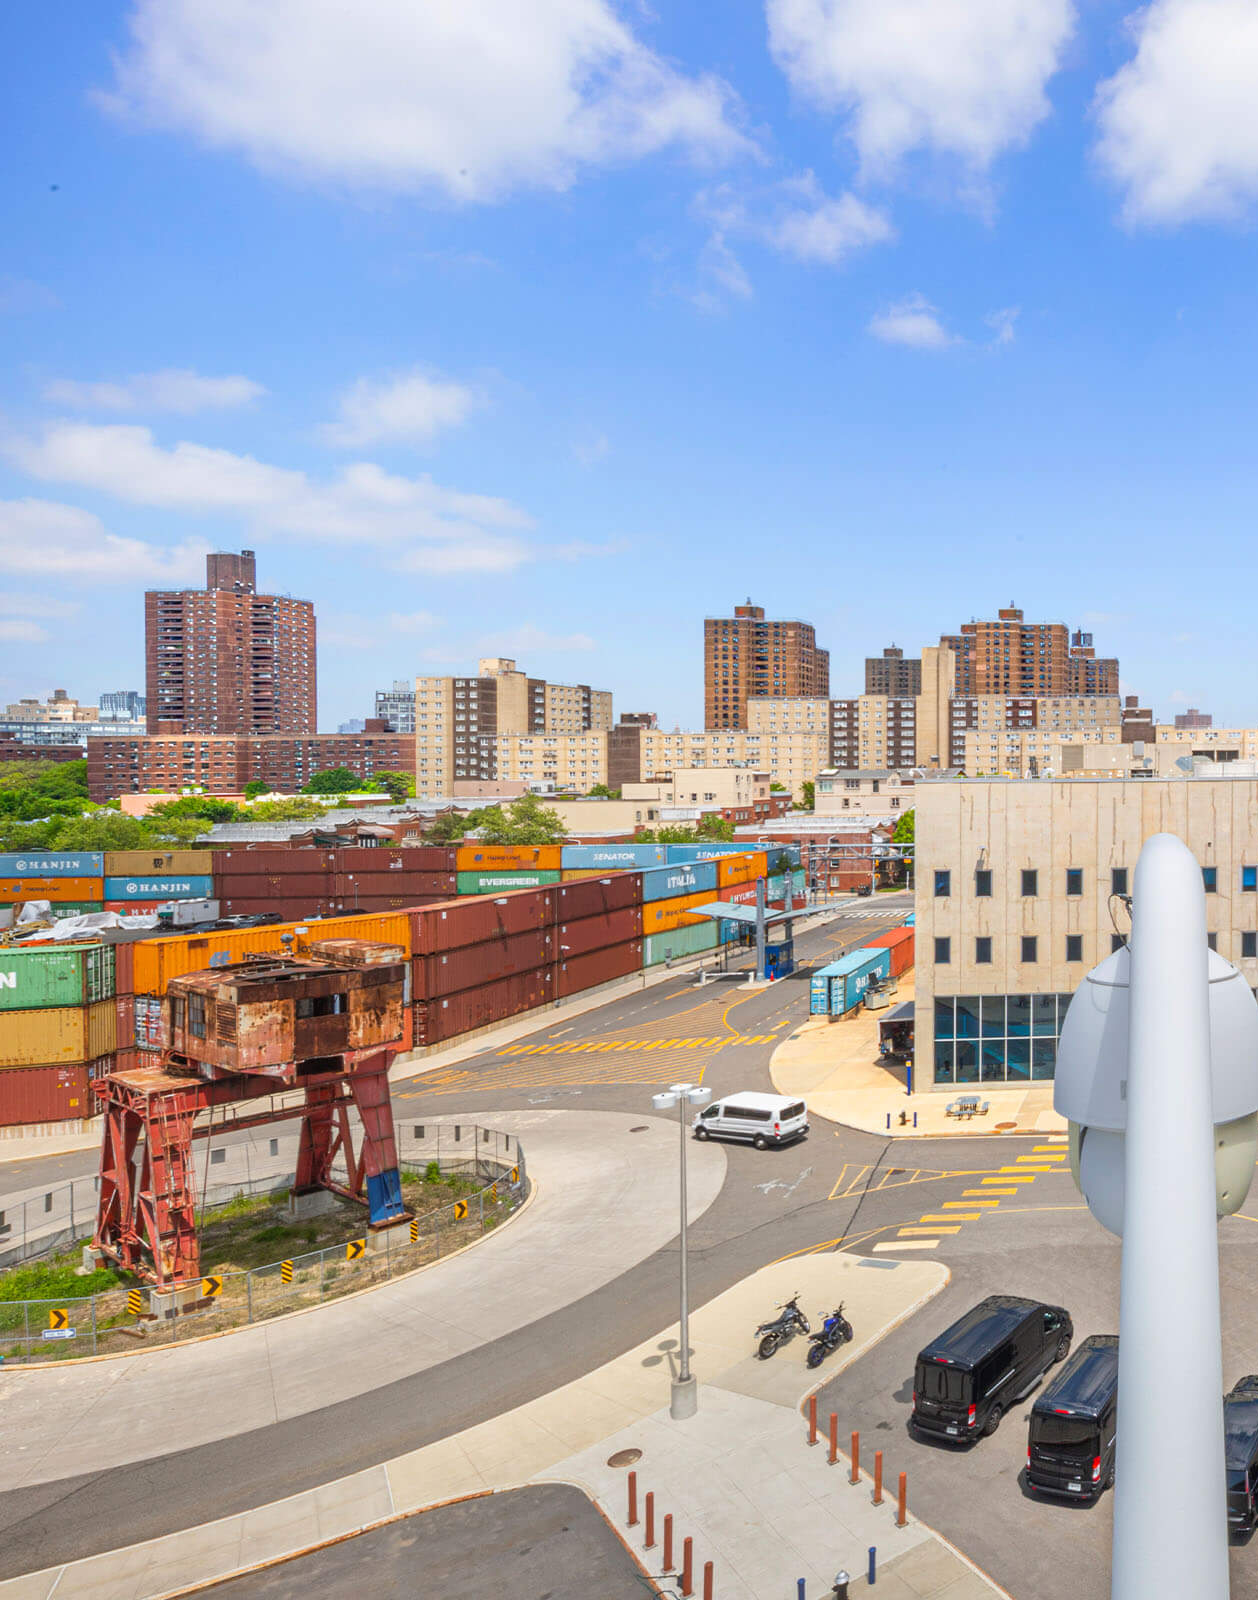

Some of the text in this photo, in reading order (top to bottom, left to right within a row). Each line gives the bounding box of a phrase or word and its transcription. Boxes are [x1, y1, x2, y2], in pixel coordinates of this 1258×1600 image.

[28, 861, 80, 870] HANJIN
[479, 877, 539, 887] EVERGREEN
[667, 873, 696, 889] ITALIA
[140, 883, 190, 892] HANJIN
